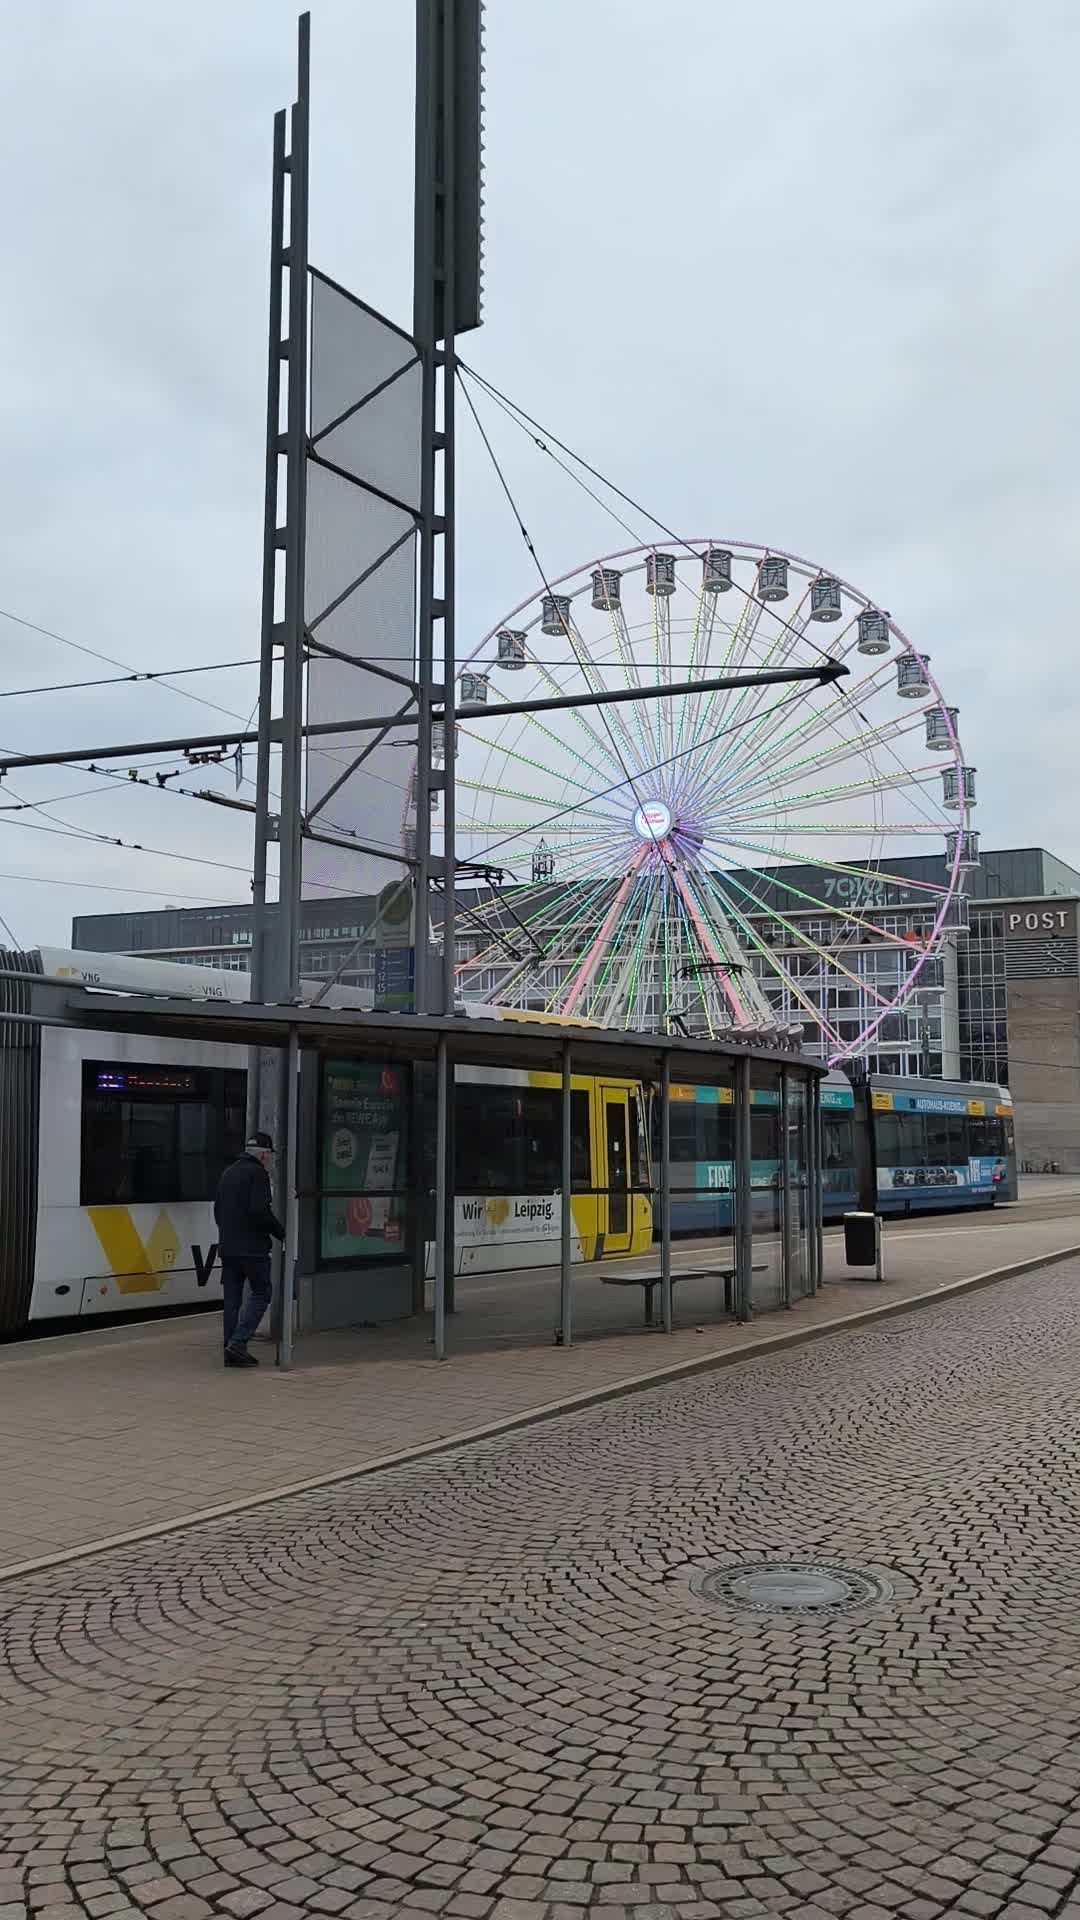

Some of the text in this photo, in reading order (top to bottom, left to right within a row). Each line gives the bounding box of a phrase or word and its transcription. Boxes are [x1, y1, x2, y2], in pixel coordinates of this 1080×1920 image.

[1009, 911, 1069, 930] POST
[81, 971, 101, 983] VNG
[202, 985, 223, 997] VNG
[377, 983, 386, 993] 15
[707, 1165, 731, 1195] FIAT
[462, 1199, 555, 1220] Wir Leipzig.
